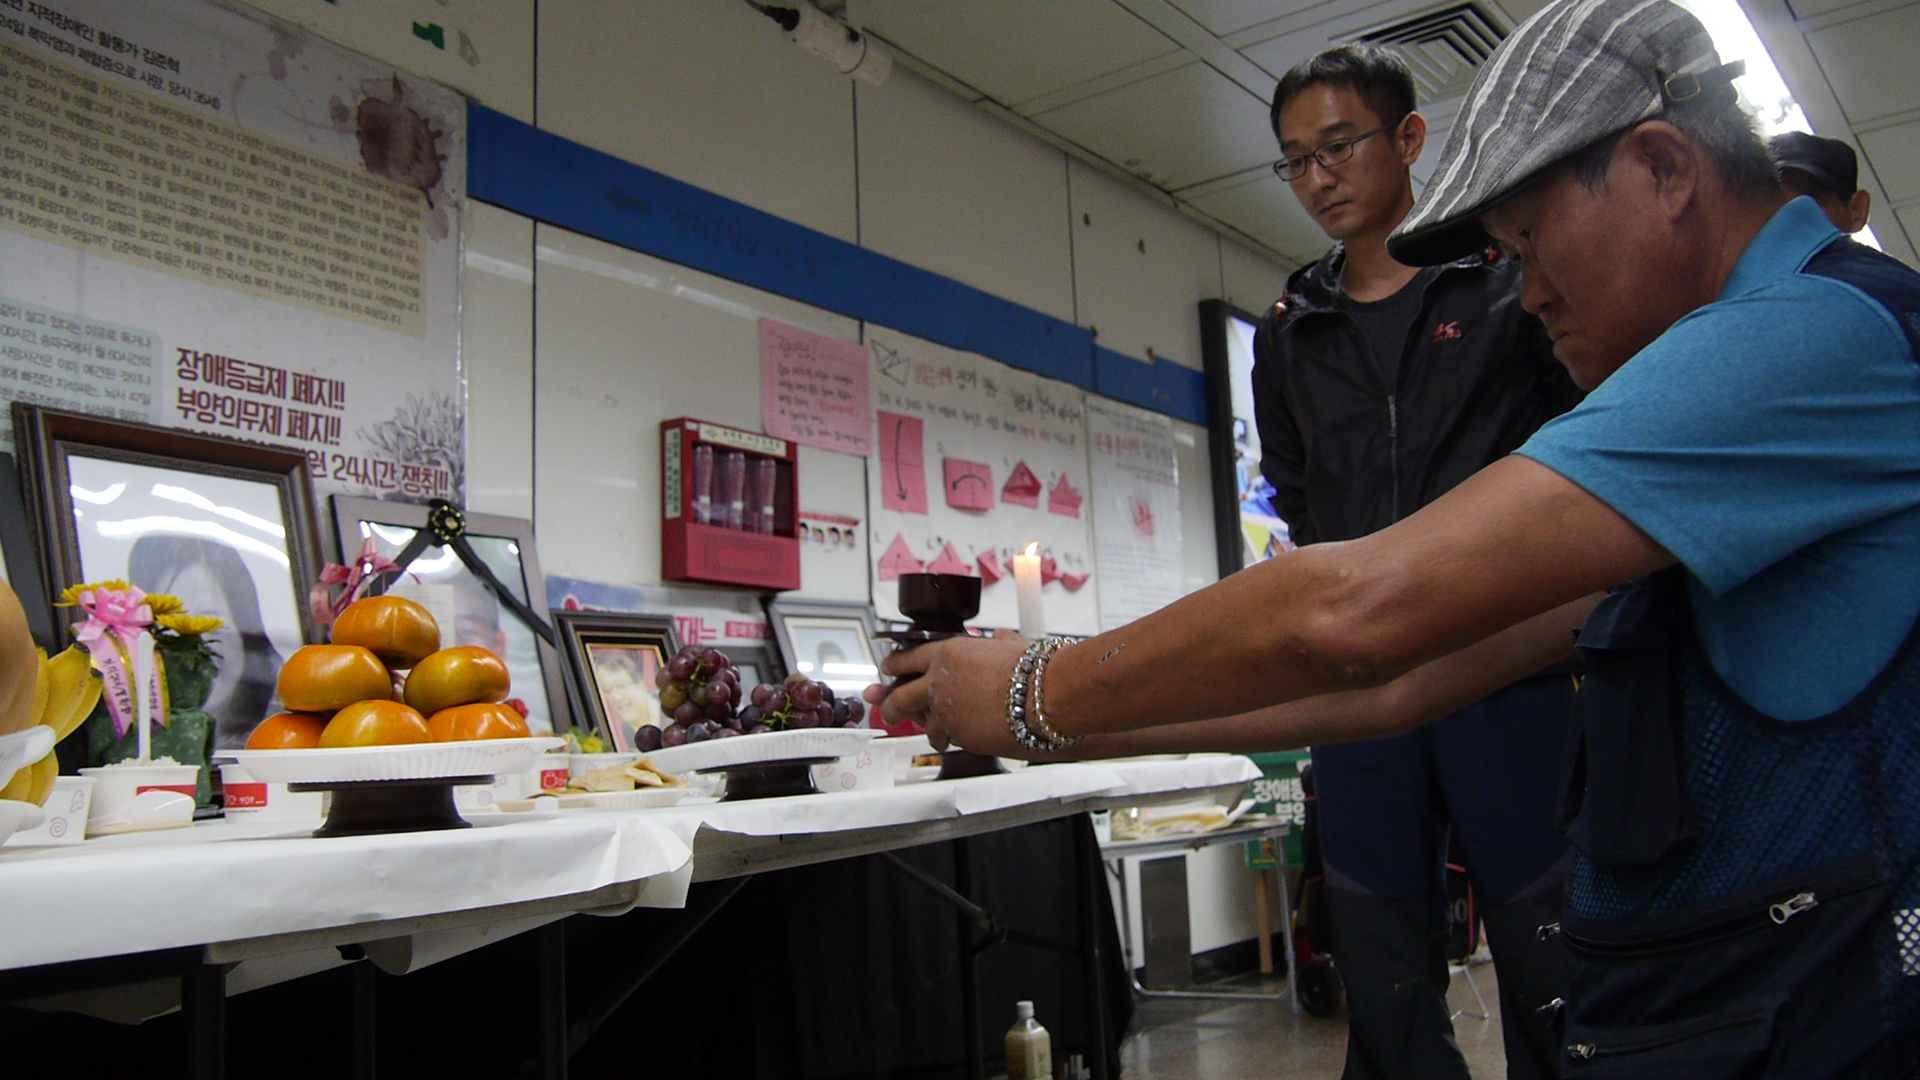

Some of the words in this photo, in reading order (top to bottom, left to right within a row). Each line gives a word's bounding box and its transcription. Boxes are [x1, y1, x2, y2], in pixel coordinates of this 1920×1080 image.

[177, 347, 287, 400] 장애등급제
[291, 371, 346, 412] 폐지!!
[176, 386, 283, 437] 부양의무제
[286, 407, 342, 447] 폐지!!
[331, 454, 398, 490] 24시간
